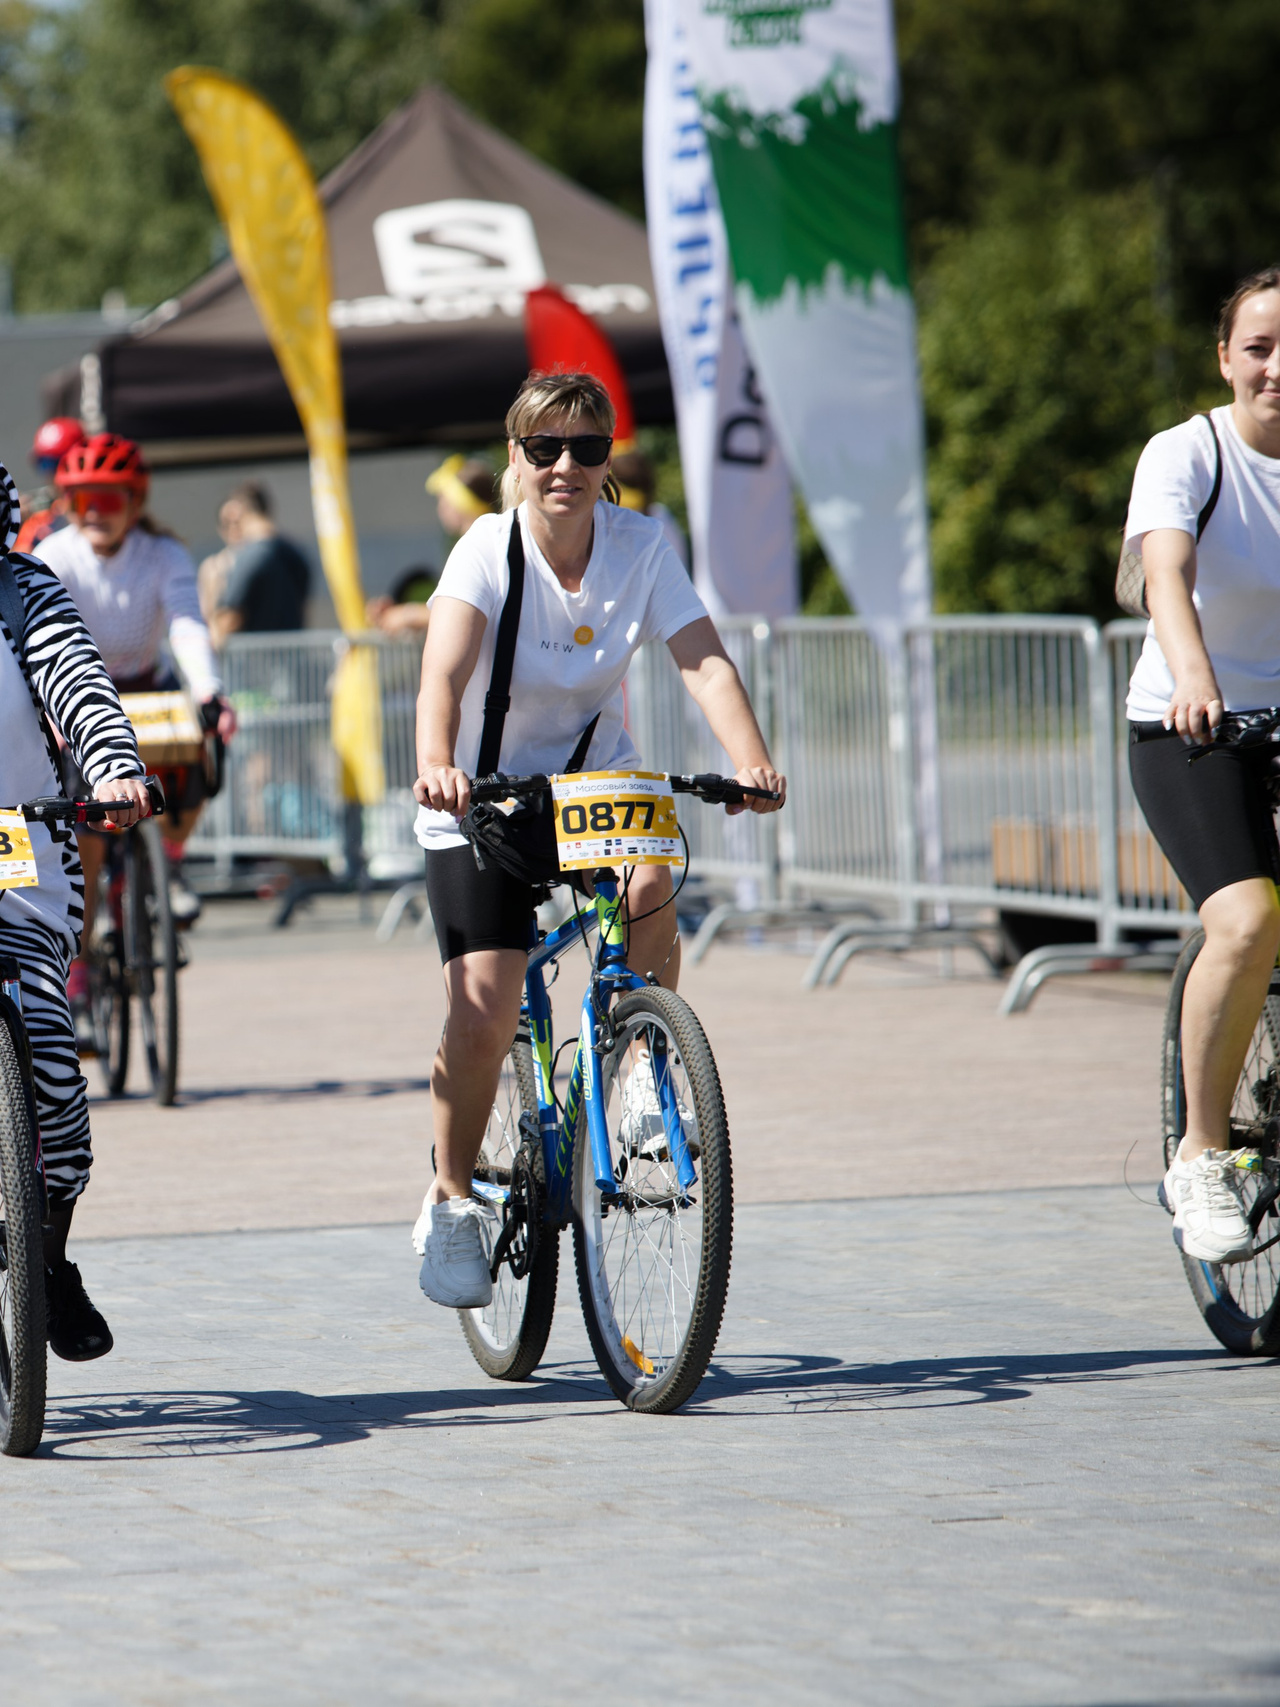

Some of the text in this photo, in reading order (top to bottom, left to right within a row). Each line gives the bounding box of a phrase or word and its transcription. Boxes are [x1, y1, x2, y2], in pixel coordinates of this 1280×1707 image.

[540, 640, 574, 653] NEW
[575, 780, 627, 793] Массовый
[628, 782, 655, 792] заезд
[561, 801, 656, 835] 0877
